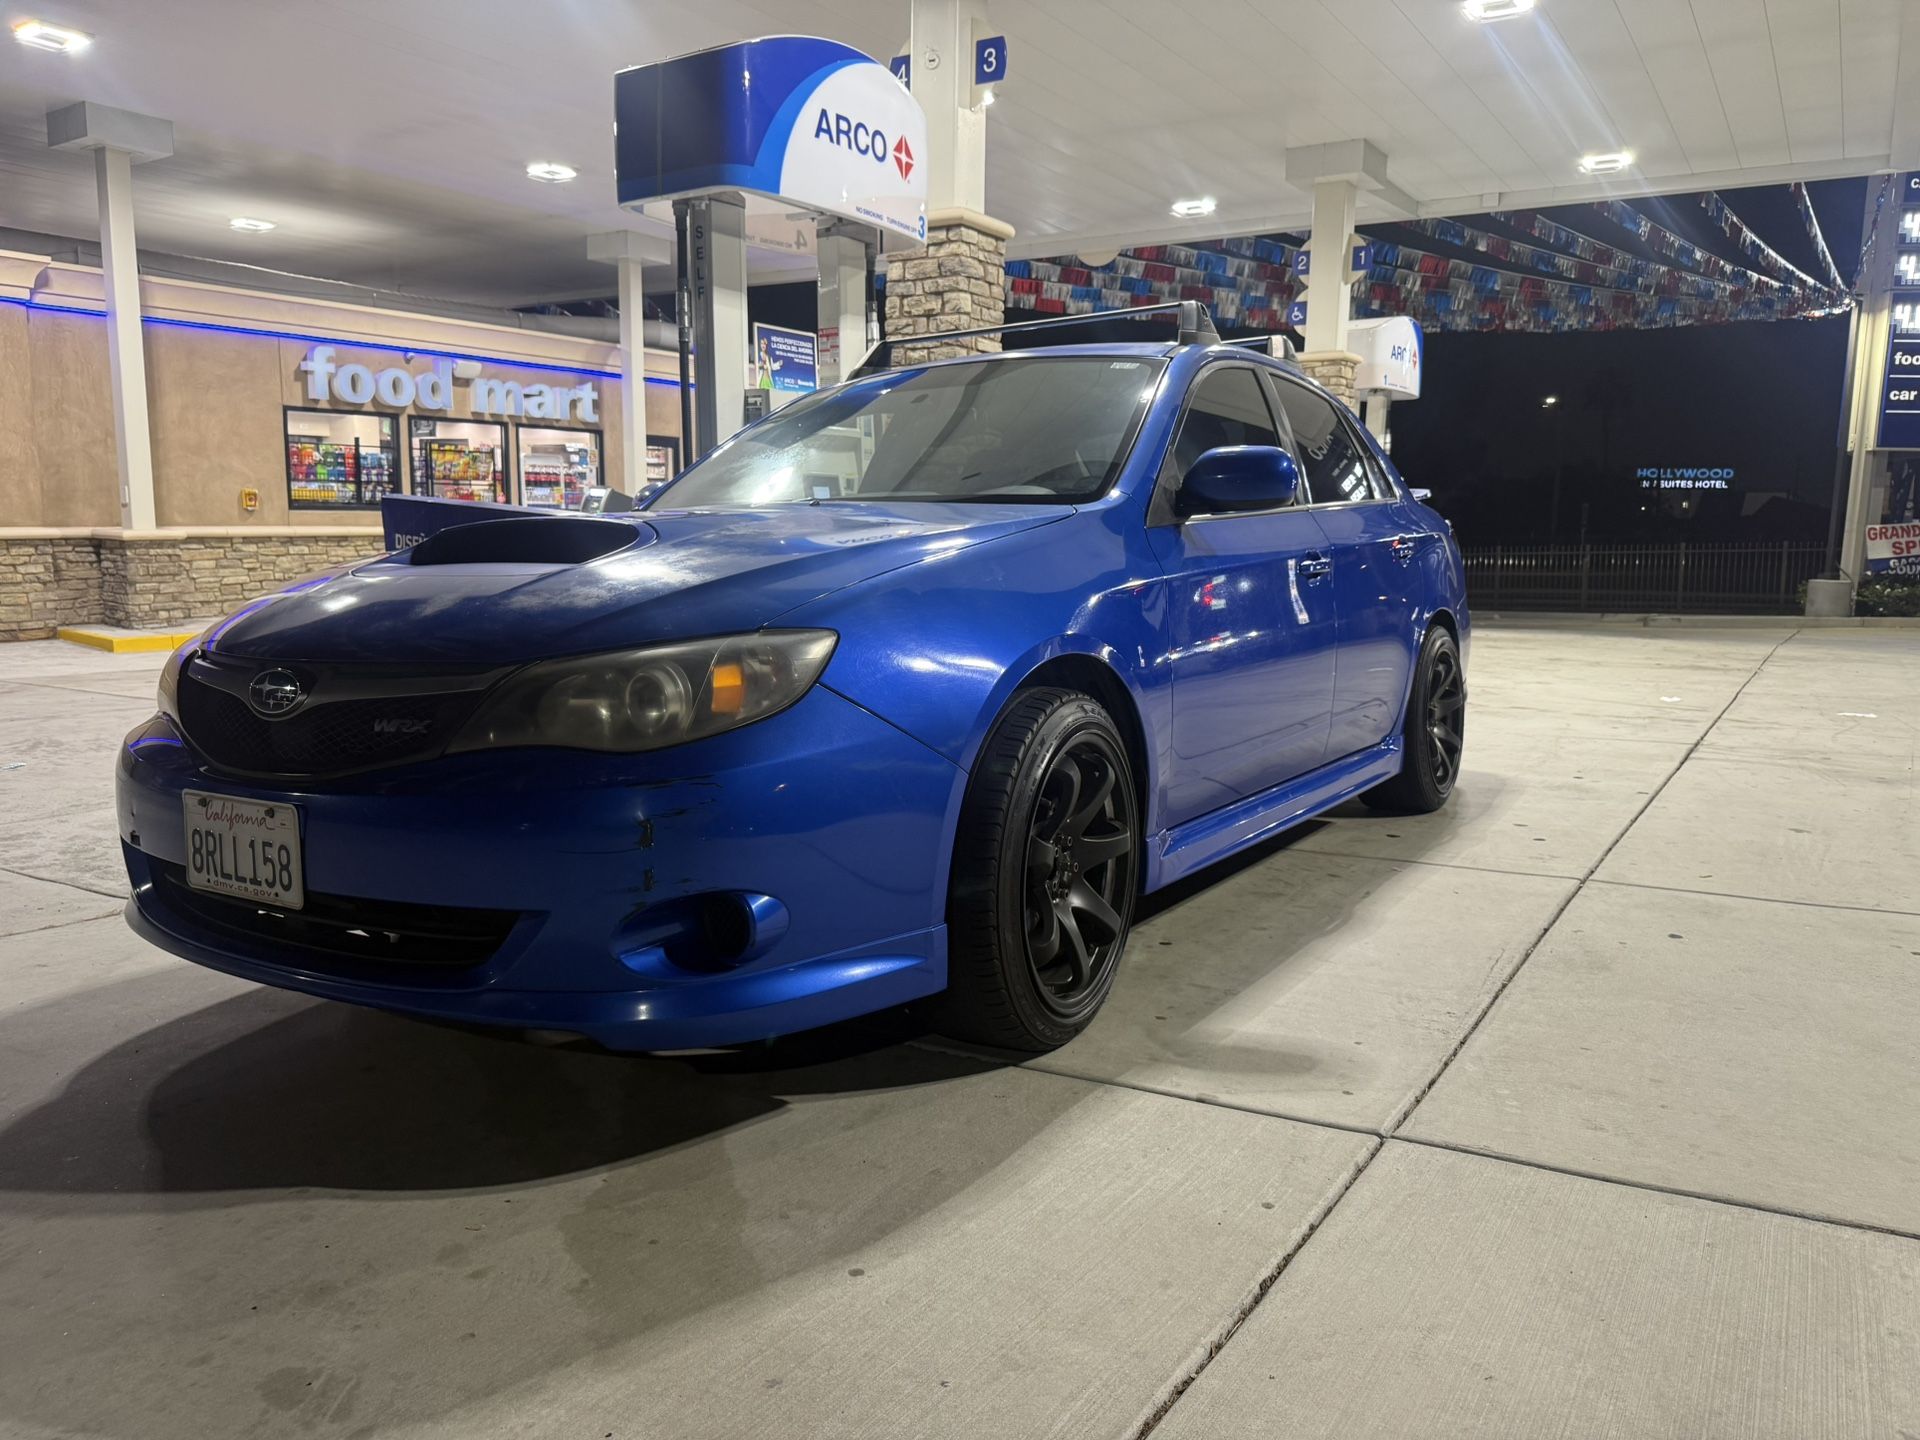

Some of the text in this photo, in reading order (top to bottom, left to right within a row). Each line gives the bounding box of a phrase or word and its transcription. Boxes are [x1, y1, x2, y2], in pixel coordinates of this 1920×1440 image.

[983, 48, 996, 72] 3
[896, 63, 908, 86] 4
[815, 107, 887, 163] ARCO
[863, 209, 883, 221] SMOKING
[918, 216, 925, 239] 3
[696, 226, 704, 299] SELF
[1298, 255, 1307, 270] 2
[1359, 250, 1366, 265] 1
[1391, 345, 1411, 363] ARC
[300, 345, 599, 423] food mart
[1384, 374, 1388, 385] 1
[1889, 390, 1917, 401] car
[1637, 468, 1734, 479] HOLLYWOOD
[1660, 480, 1693, 489] SUITES
[1695, 480, 1728, 489] HOTEL
[1892, 540, 1920, 556] SP
[374, 718, 432, 734] WRX
[205, 800, 276, 831] California
[191, 827, 293, 892] 8RLL158
[213, 880, 272, 897] dmv.ca.gov
